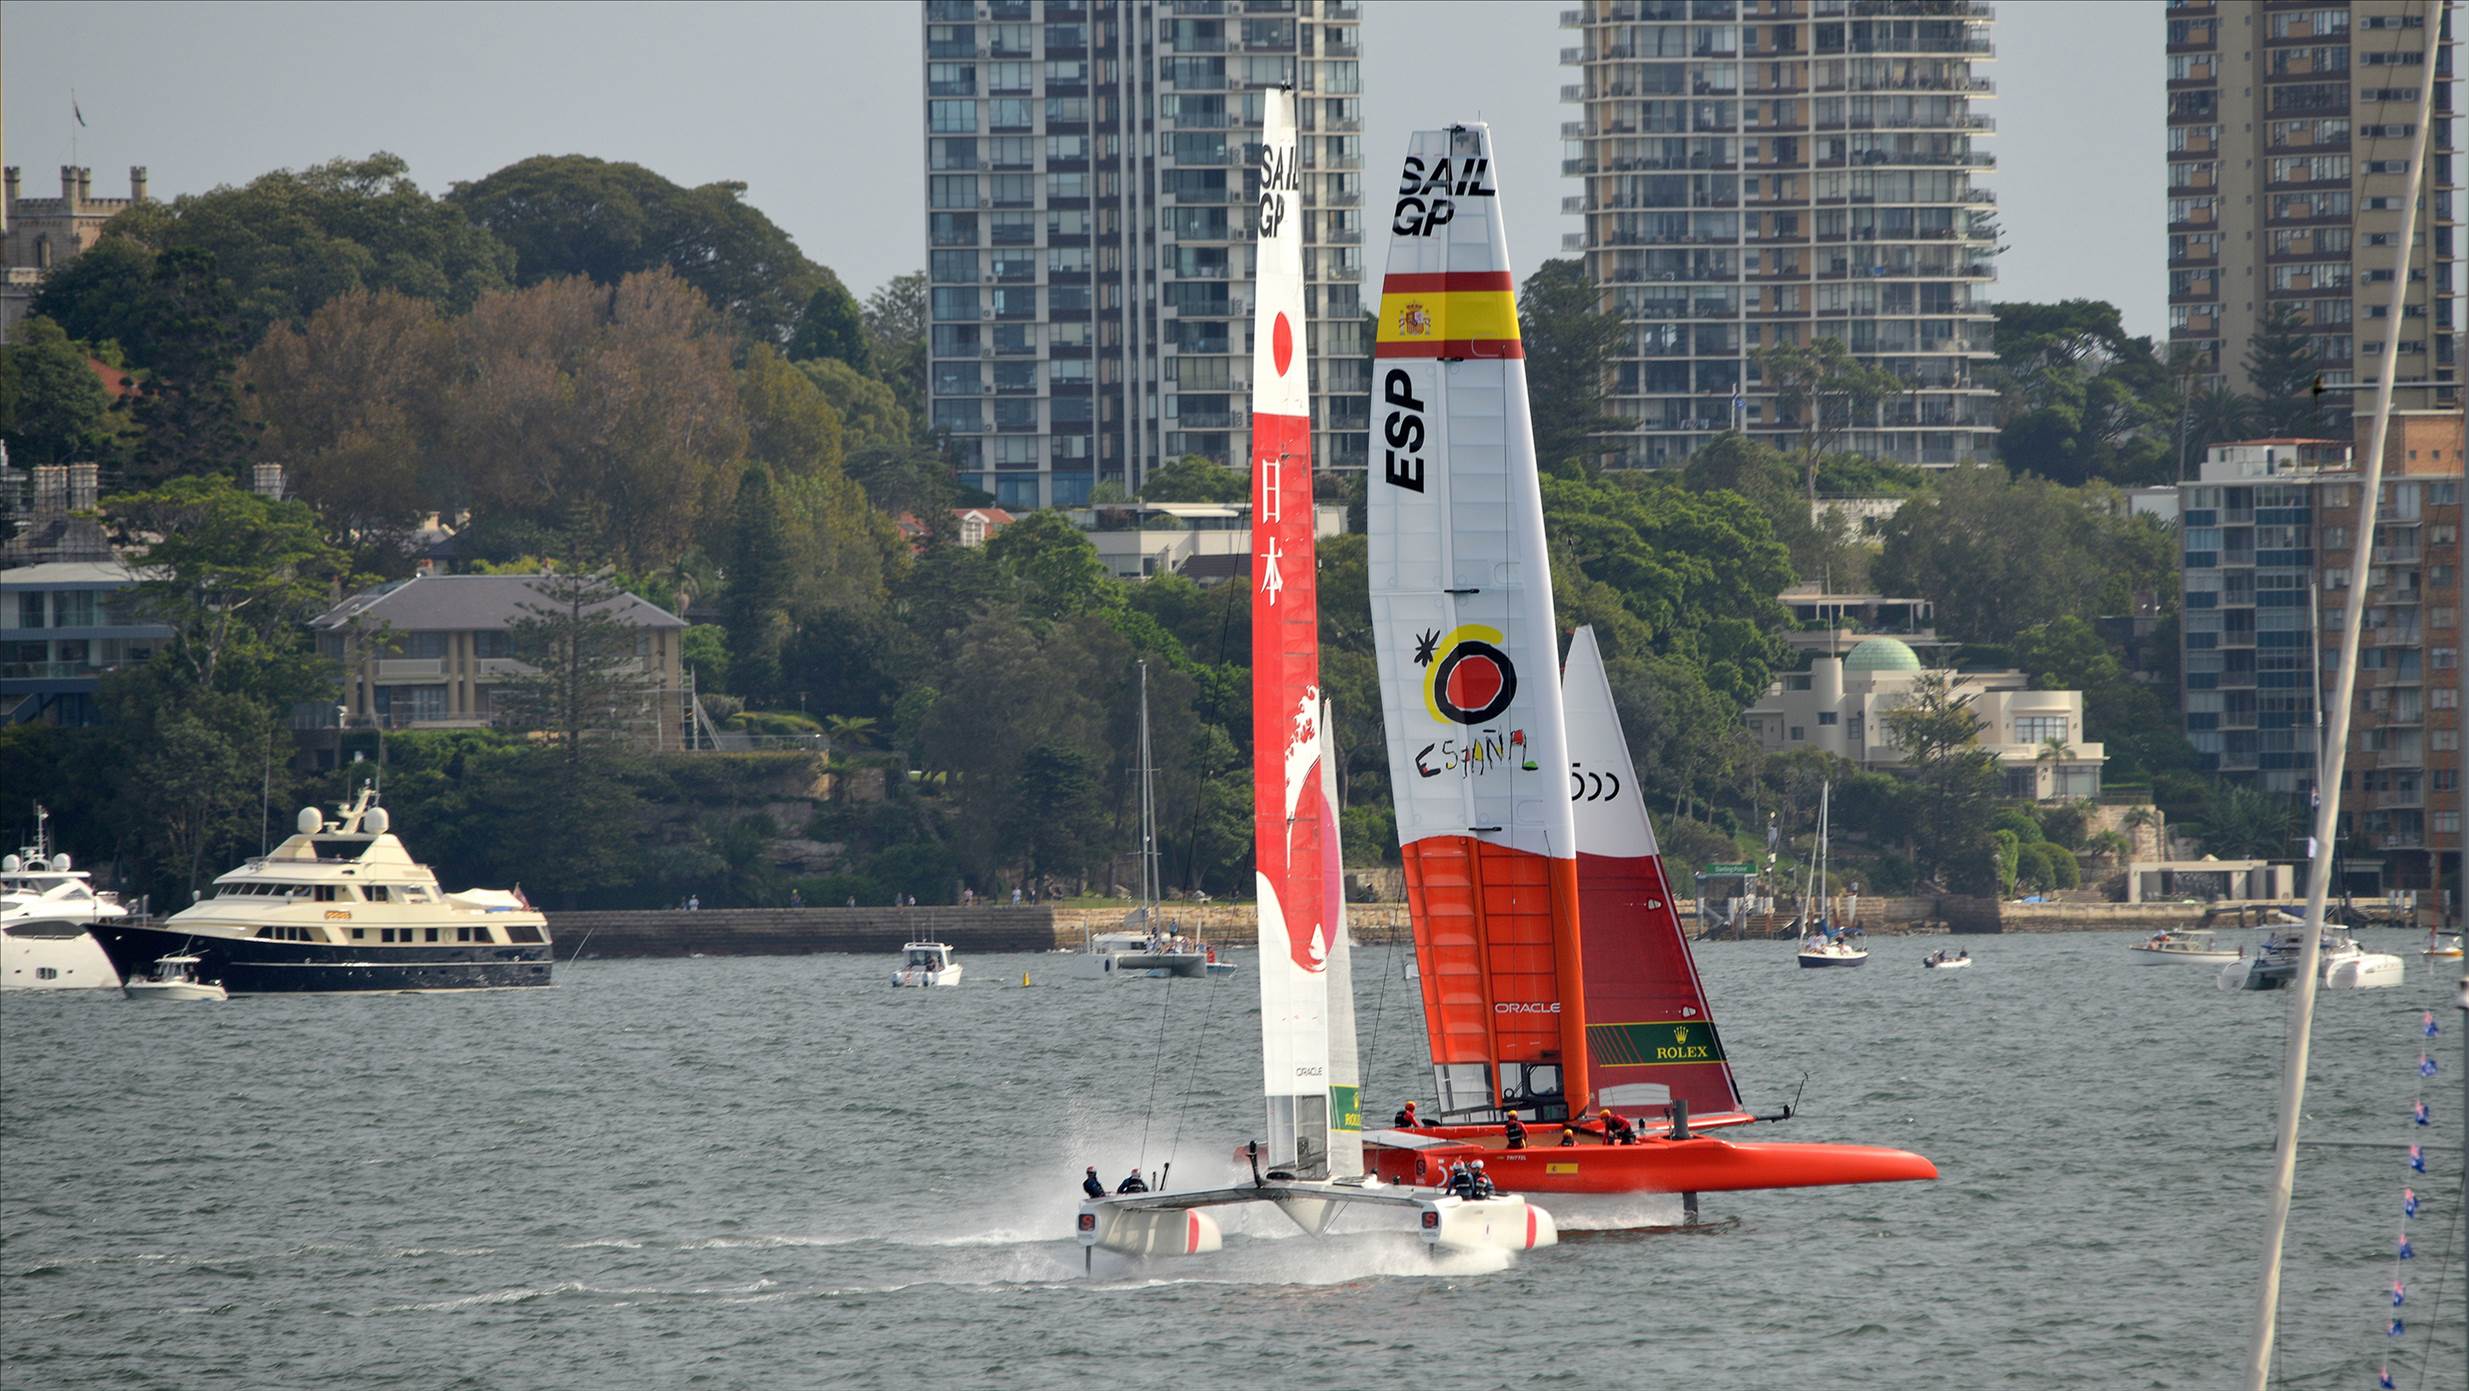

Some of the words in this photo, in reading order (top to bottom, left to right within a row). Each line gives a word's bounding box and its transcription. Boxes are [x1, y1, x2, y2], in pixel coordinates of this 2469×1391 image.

[1261, 144, 1299, 191] SAIL
[1399, 156, 1497, 197] SAIL
[1259, 192, 1285, 239] GP
[1392, 198, 1455, 238] GP
[1384, 367, 1425, 494] ESP
[1260, 458, 1283, 607] 日本
[1495, 1002, 1561, 1013] ORACLE
[1656, 1046, 1708, 1059] ROLEX
